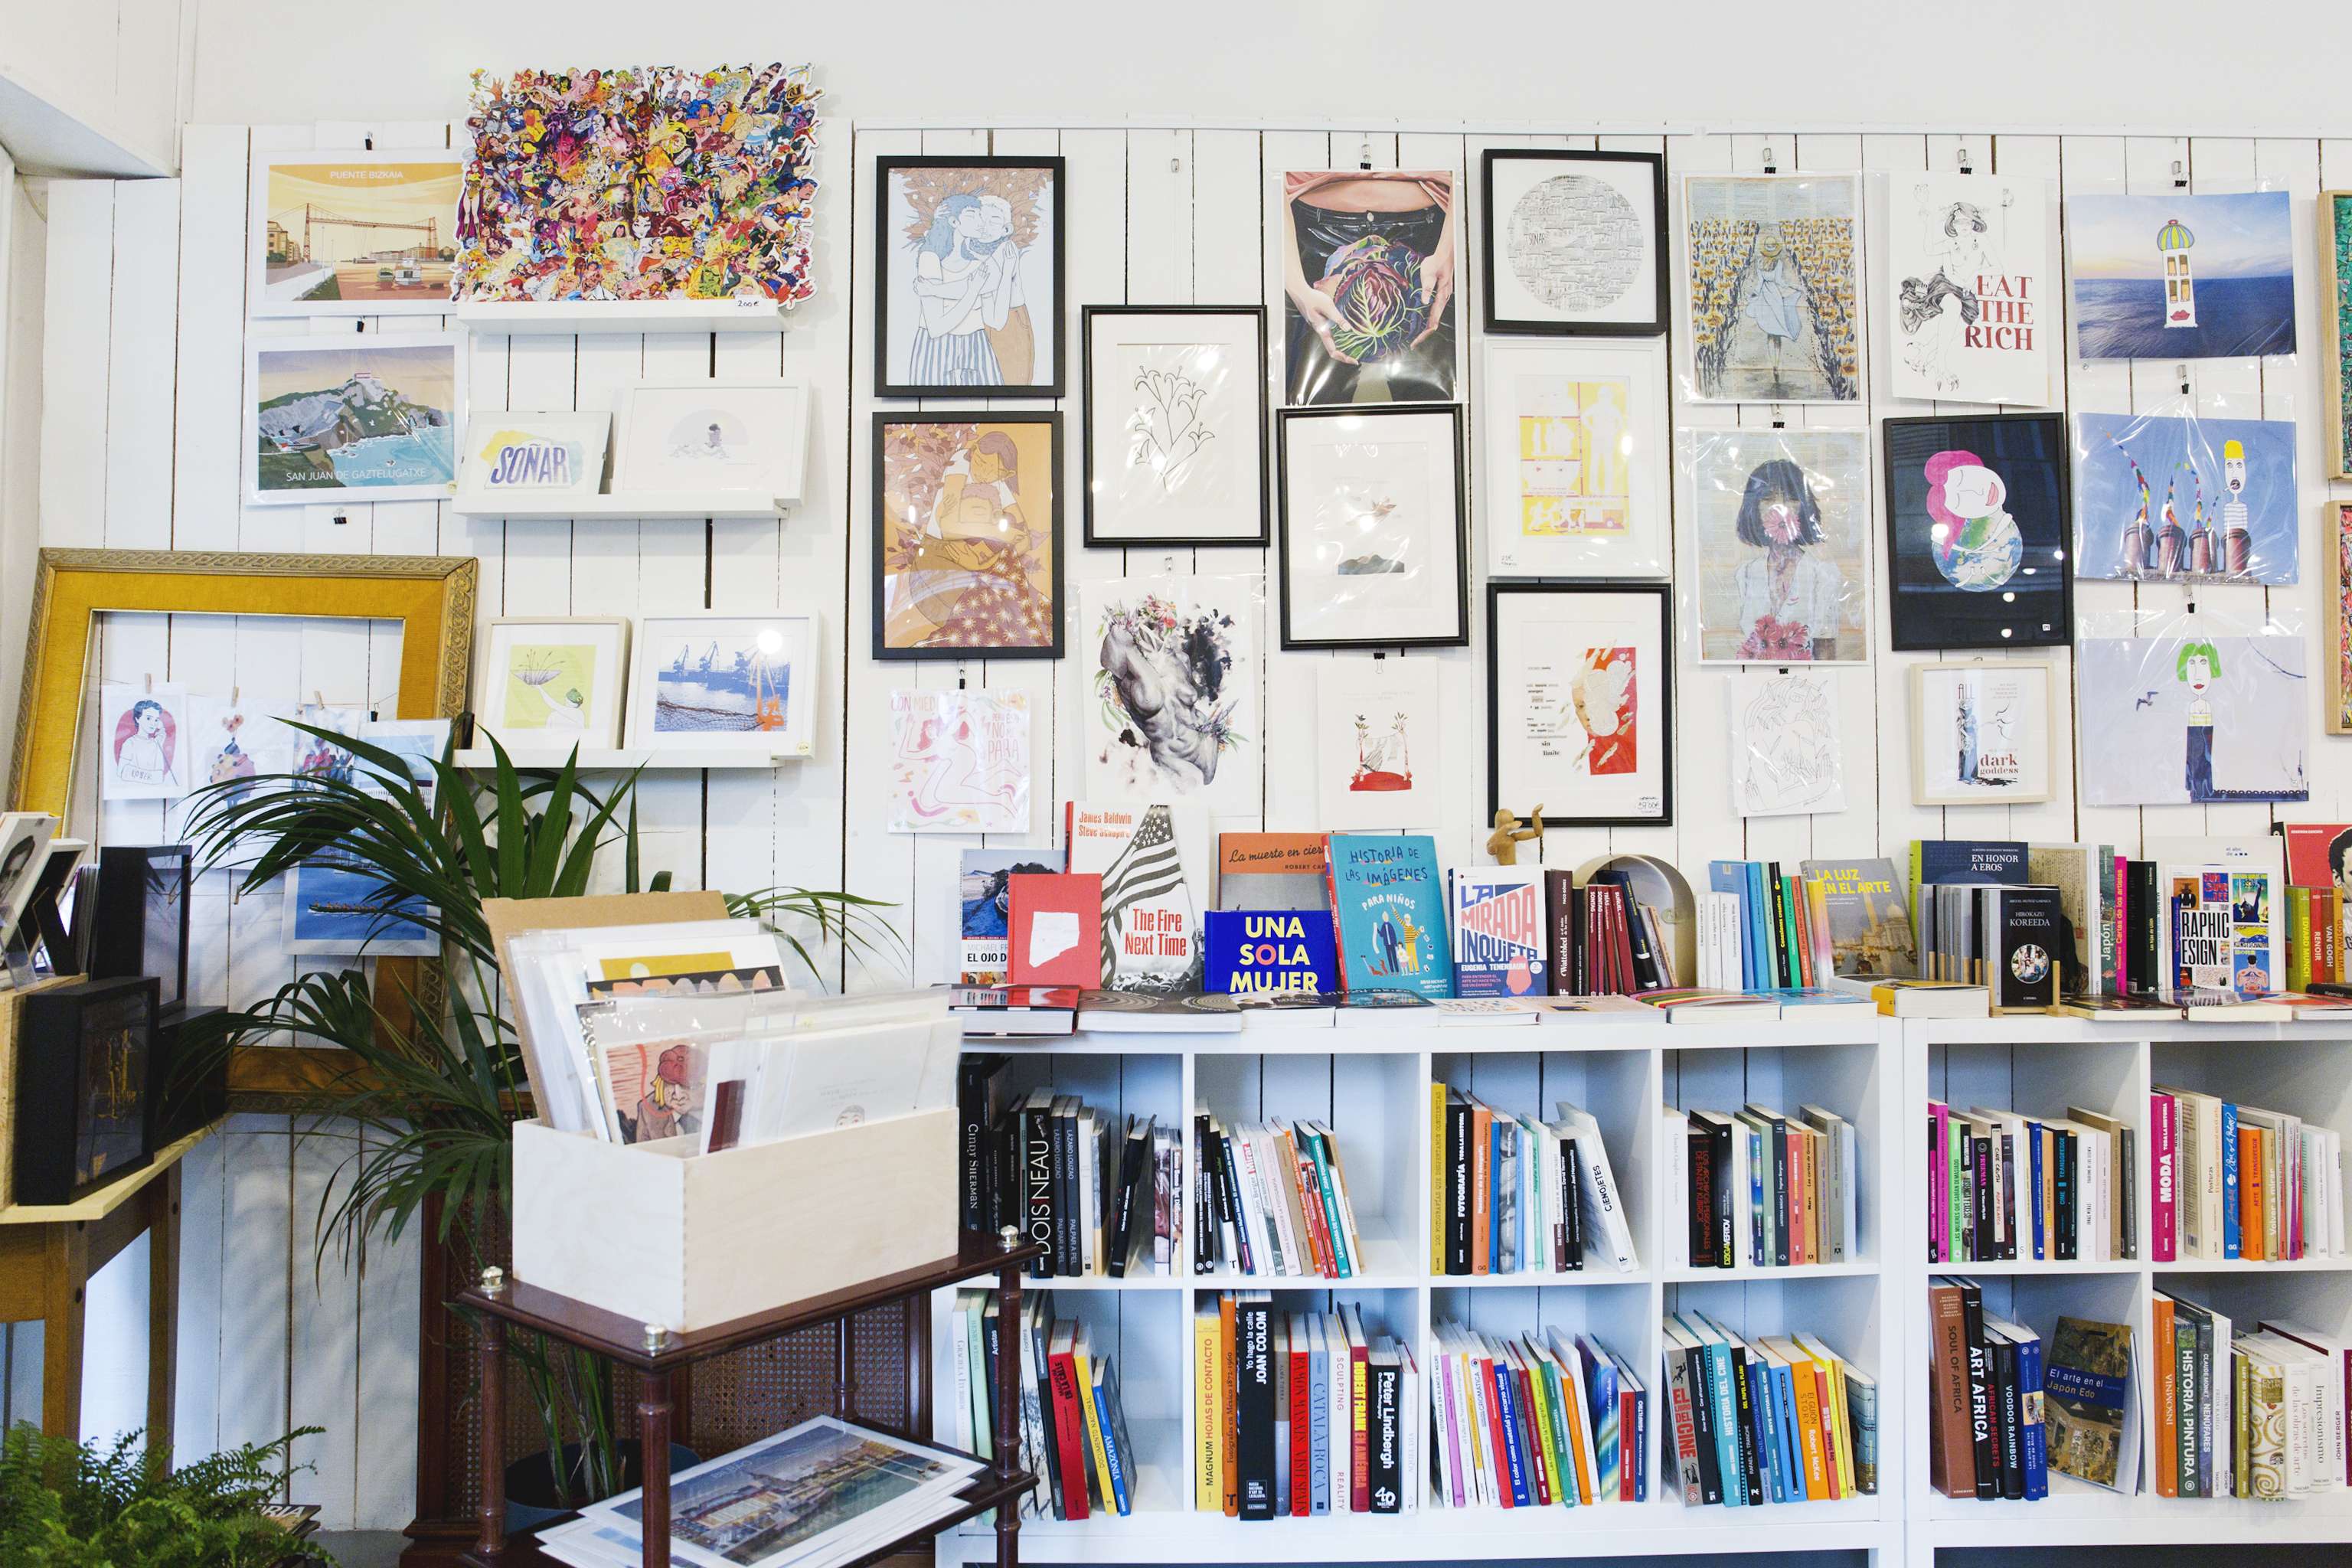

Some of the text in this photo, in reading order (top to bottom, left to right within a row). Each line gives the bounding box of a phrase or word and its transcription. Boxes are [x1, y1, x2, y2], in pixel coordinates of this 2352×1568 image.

[1977, 276, 2033, 299] EAT
[1981, 301, 2034, 325] THE
[1965, 325, 2034, 351] RICH
[286, 468, 426, 482] SAN JUAN DE GAZTELUGATXE
[491, 443, 569, 484] SOÑAR
[891, 695, 938, 711] CON MIED
[1980, 767, 2018, 776] goddess
[1981, 754, 2017, 766] dark
[1080, 812, 1132, 825] James Baldwin
[1229, 850, 1246, 863] La
[1250, 851, 1284, 860] muerte
[1303, 844, 1324, 855] cier
[1350, 846, 1419, 863] HISTORIA DE
[1971, 854, 2019, 863] EN HONOR
[1345, 867, 1428, 886] LAS IMÁGENES
[1815, 870, 1860, 880] LA LUZ
[1462, 884, 1493, 909] LA
[1840, 883, 1855, 894] EL
[1857, 882, 1891, 893] ARTE
[1361, 893, 1416, 910] PARA NIÑOS
[1132, 908, 1181, 933] The Fire
[1462, 885, 1537, 947] MIRADA
[2115, 909, 2122, 919] de
[2182, 912, 2230, 938] RAPHIC
[1245, 917, 1305, 938] UNA
[1125, 933, 1187, 956] Next Time
[2101, 923, 2114, 960] Japón
[2183, 939, 2217, 965] ESIGN
[968, 953, 1007, 962] EL OJO D
[1240, 944, 1311, 965] SOLA
[1230, 972, 1318, 992] MUJER
[1250, 1177, 1259, 1198] Berger
[1246, 1341, 1256, 1359] hago
[1256, 1312, 1267, 1384] JOAN COLOM
[1948, 1325, 1958, 1354] SOUL
[1204, 1339, 1213, 1385] CONTACTO
[1246, 1360, 1253, 1370] Yo
[1950, 1357, 1959, 1371] OF
[2050, 1368, 2060, 1378] El
[2063, 1374, 2080, 1383] arte
[1205, 1393, 1213, 1405] DE
[1717, 1356, 1734, 1436] HISTORIA DEL CINE
[1952, 1374, 1962, 1413] AFRICA
[1969, 1346, 1988, 1442] ART AFRICA
[2047, 1381, 2095, 1398] Japón Edo
[2165, 1374, 2174, 1426] INSOMNIA
[2292, 1386, 2300, 1396] de
[1501, 1393, 1511, 1413] recurso
[1800, 1393, 1809, 1425] STORY
[2182, 1350, 2195, 1477] HISTORIA PINTURA
[1354, 1361, 1369, 1488] ROBERT FRANK EN AMÉRICA
[1380, 1371, 1395, 1468] Peter Lindbergh
[1987, 1383, 2001, 1468] AFRICAN SECRETS
[2005, 1384, 2017, 1469] VOODOO RAINBOW
[2203, 1403, 2213, 1452] NENÚFARES
[2292, 1415, 2301, 1441] obras
[2313, 1385, 2325, 1464] Impresionismo
[1086, 1396, 1105, 1469] DOCUMENTO NACIONAL
[1504, 1419, 1516, 1444] material
[1103, 1435, 1120, 1481] AMAZÔNIA
[1808, 1429, 1821, 1481] Robert McKee
[2294, 1443, 2301, 1454] de
